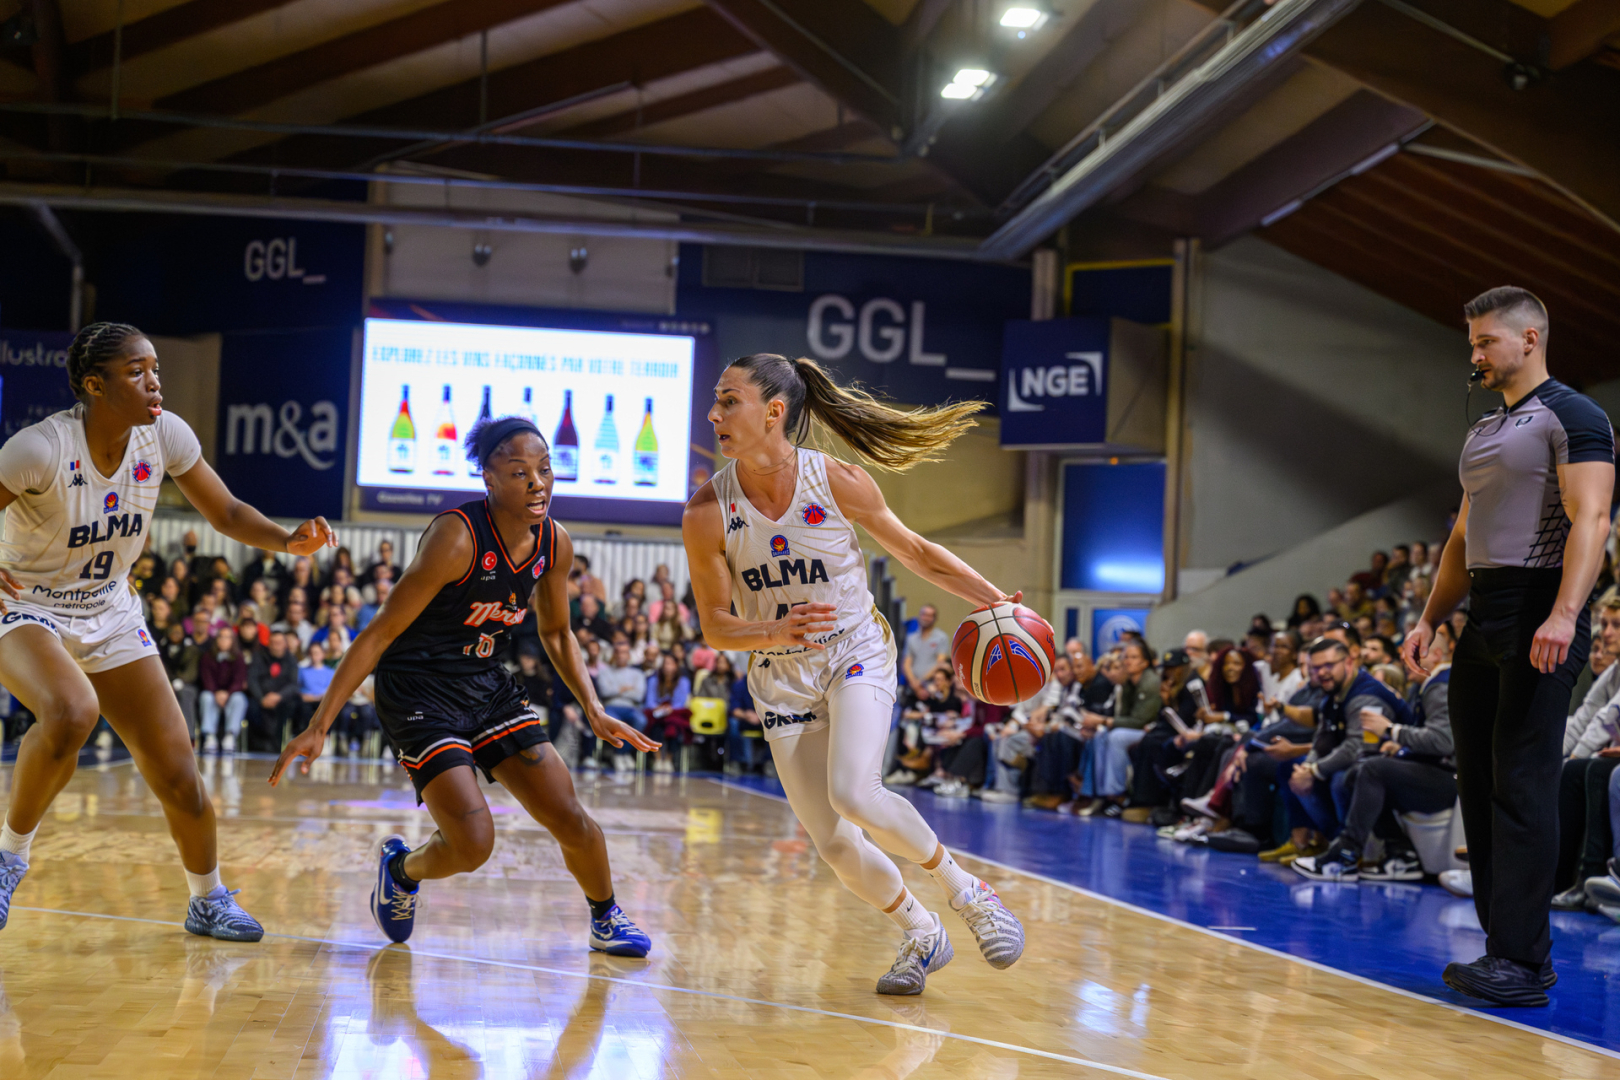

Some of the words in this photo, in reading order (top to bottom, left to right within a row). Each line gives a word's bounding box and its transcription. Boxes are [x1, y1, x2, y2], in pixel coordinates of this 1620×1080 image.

[436, 349, 457, 365] LES
[463, 351, 489, 367] VINS
[561, 356, 582, 373] PAR
[588, 358, 624, 375] VOTRE
[1021, 365, 1089, 396] NGE
[227, 400, 339, 471] m&a
[67, 513, 143, 548] BLMA
[79, 550, 115, 580] 19
[741, 558, 830, 592] BLMA
